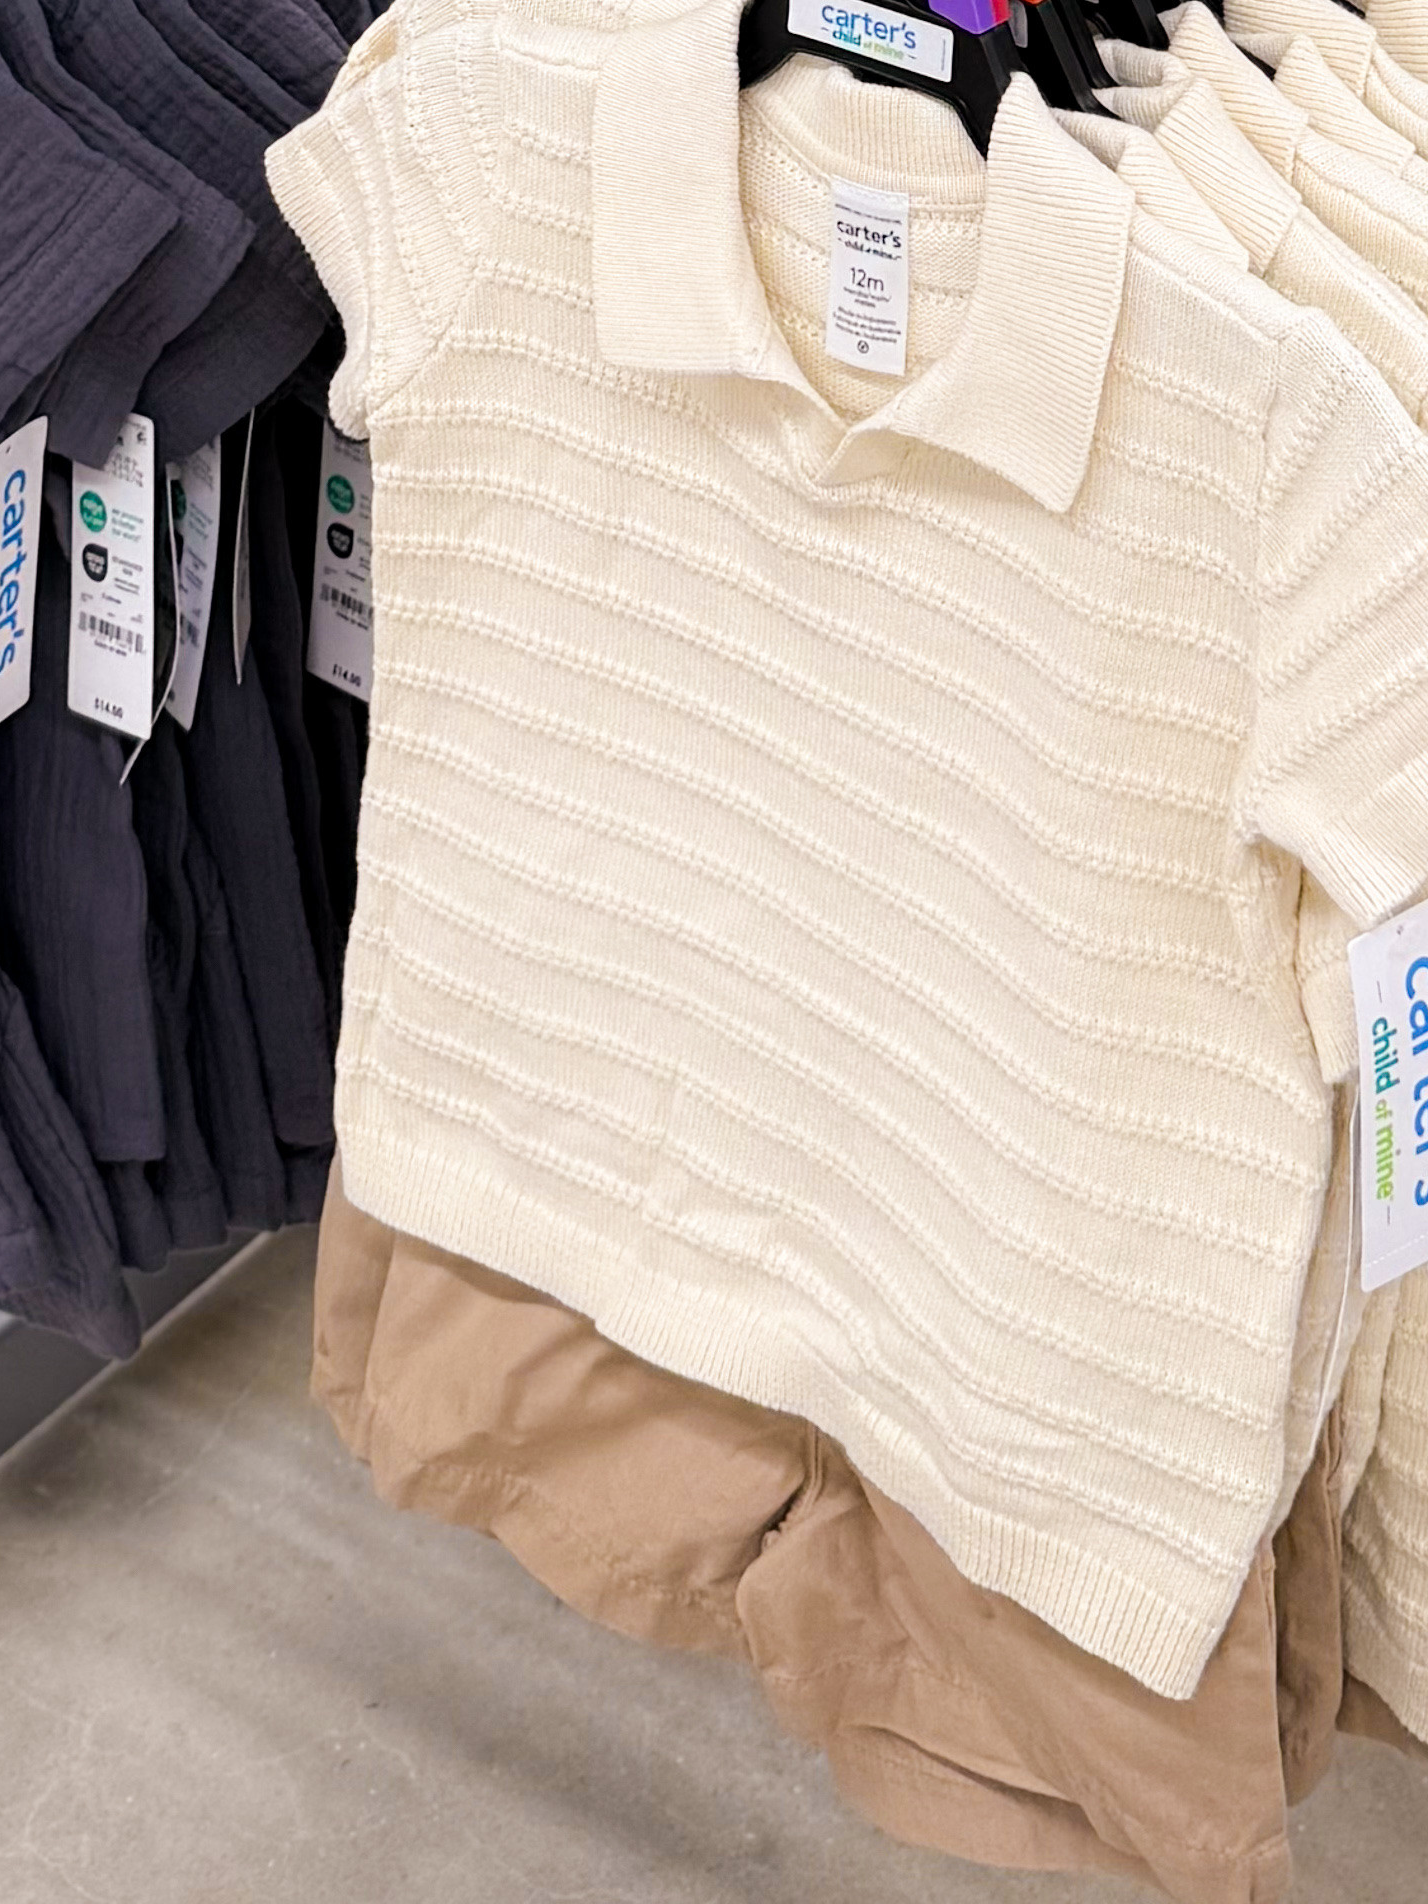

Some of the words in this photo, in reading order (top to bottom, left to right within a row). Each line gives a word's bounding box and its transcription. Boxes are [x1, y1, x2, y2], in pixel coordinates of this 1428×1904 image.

[822, 5, 917, 49] carter's
[832, 29, 862, 47] child
[837, 220, 901, 248] carter's
[850, 267, 884, 292] 12m
[1372, 1017, 1400, 1094] child
[1376, 1099, 1393, 1120] of
[1376, 1123, 1401, 1200] mine
